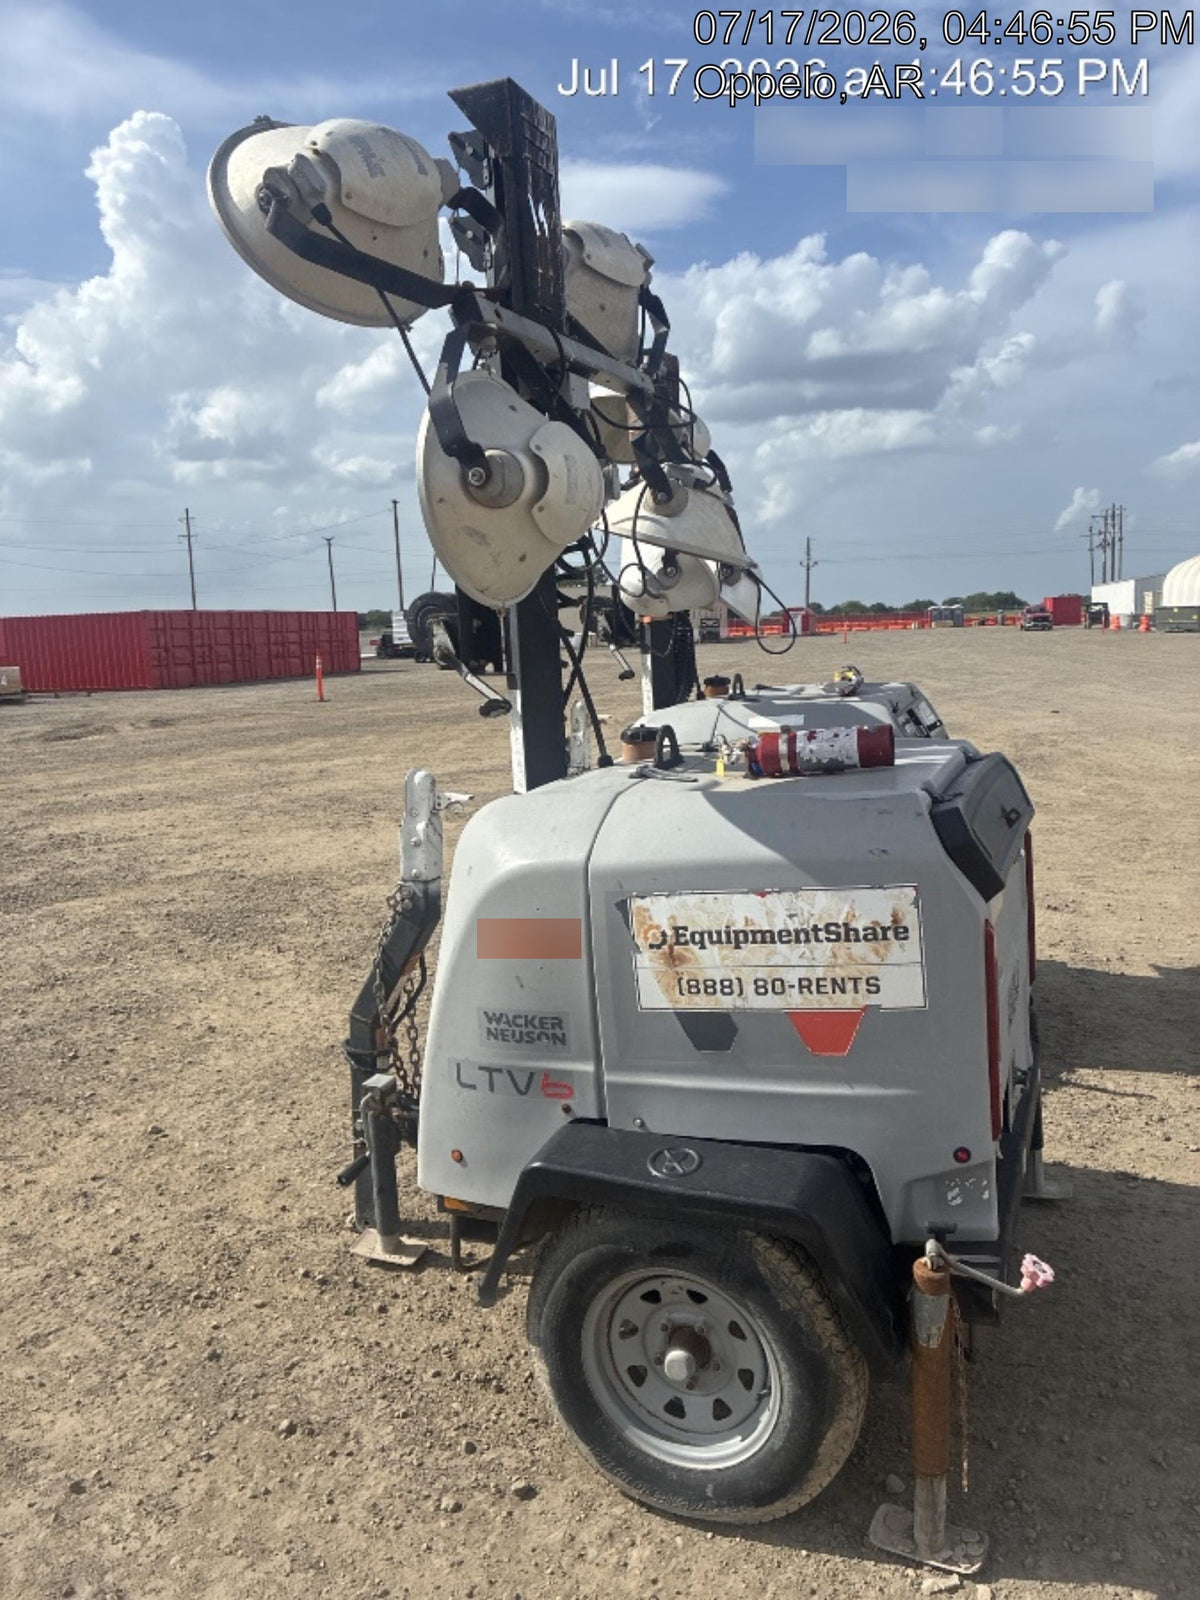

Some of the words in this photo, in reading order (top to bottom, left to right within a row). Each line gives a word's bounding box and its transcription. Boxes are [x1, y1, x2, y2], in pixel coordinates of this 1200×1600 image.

[673, 922, 910, 950] EquipmentShare
[677, 978, 744, 997] (888)
[753, 976, 881, 996] 80-RENTS
[483, 1010, 564, 1031] WACKER
[486, 1027, 568, 1047] NEUSON
[456, 1062, 575, 1100] LTV6
